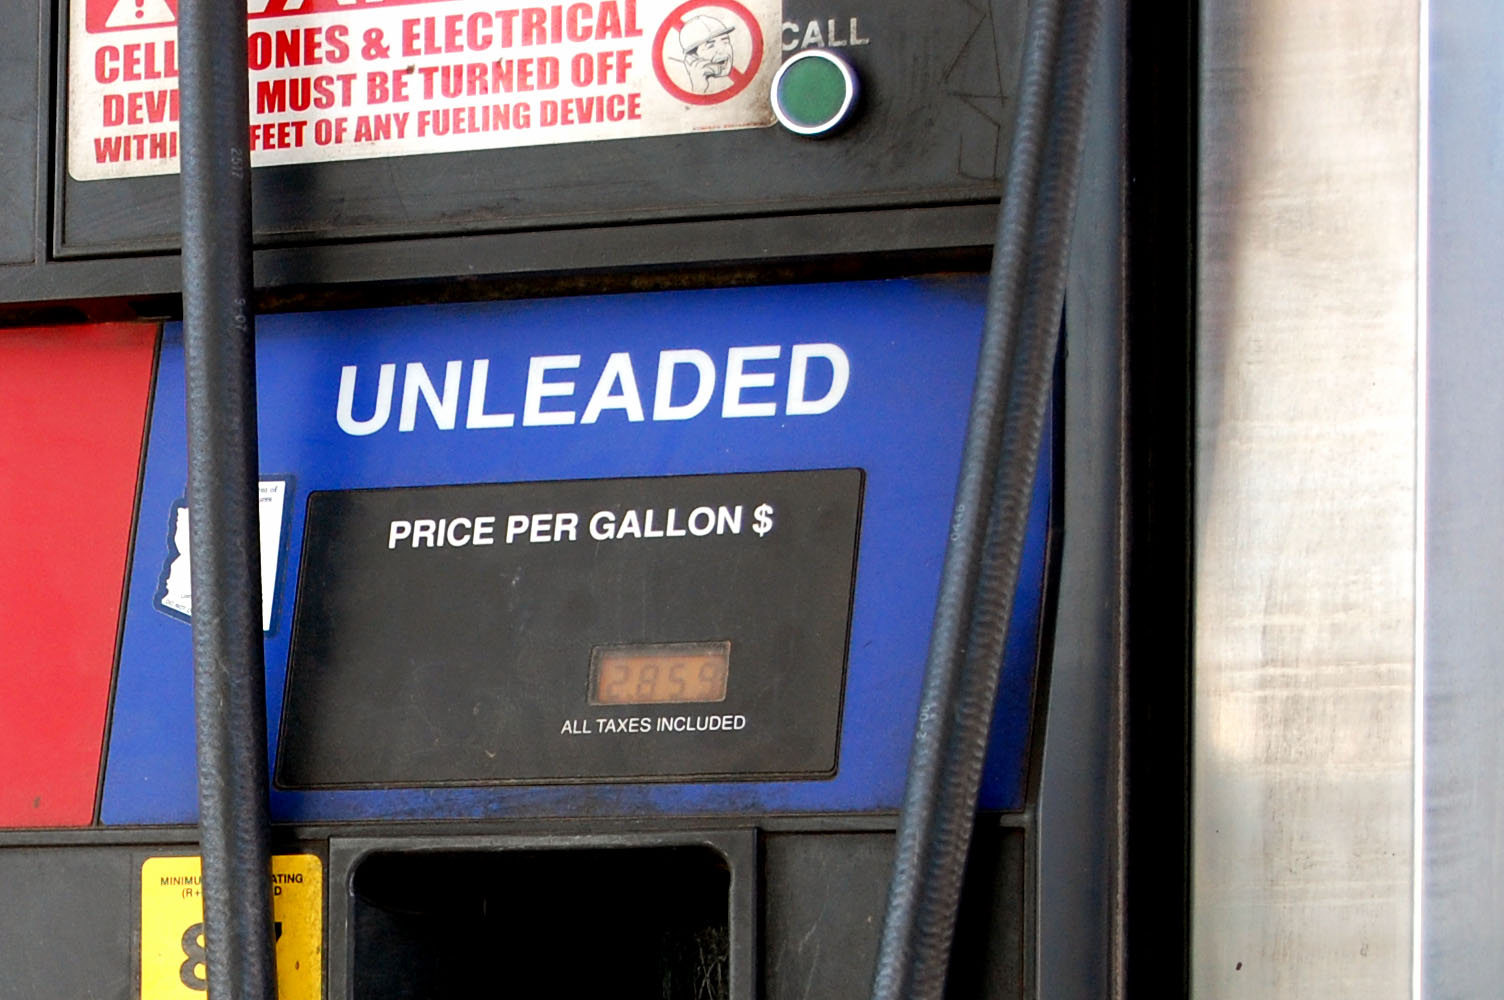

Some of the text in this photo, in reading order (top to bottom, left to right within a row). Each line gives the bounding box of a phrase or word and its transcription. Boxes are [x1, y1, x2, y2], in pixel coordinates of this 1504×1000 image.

[94, 0, 644, 84] CELL ONES & ELECTRICAL
[782, 17, 870, 51] CALL
[103, 50, 633, 127] DEVI MUST BE TURNED OFF
[94, 93, 642, 164] WITHI FEET OF ANY FUELING DEVICE
[336, 342, 851, 437] UNLEADED
[388, 503, 775, 550] PRICE PER GALLON $
[561, 715, 746, 735] ALL TAXES INCLUDED
[160, 876, 202, 886] MINIMU
